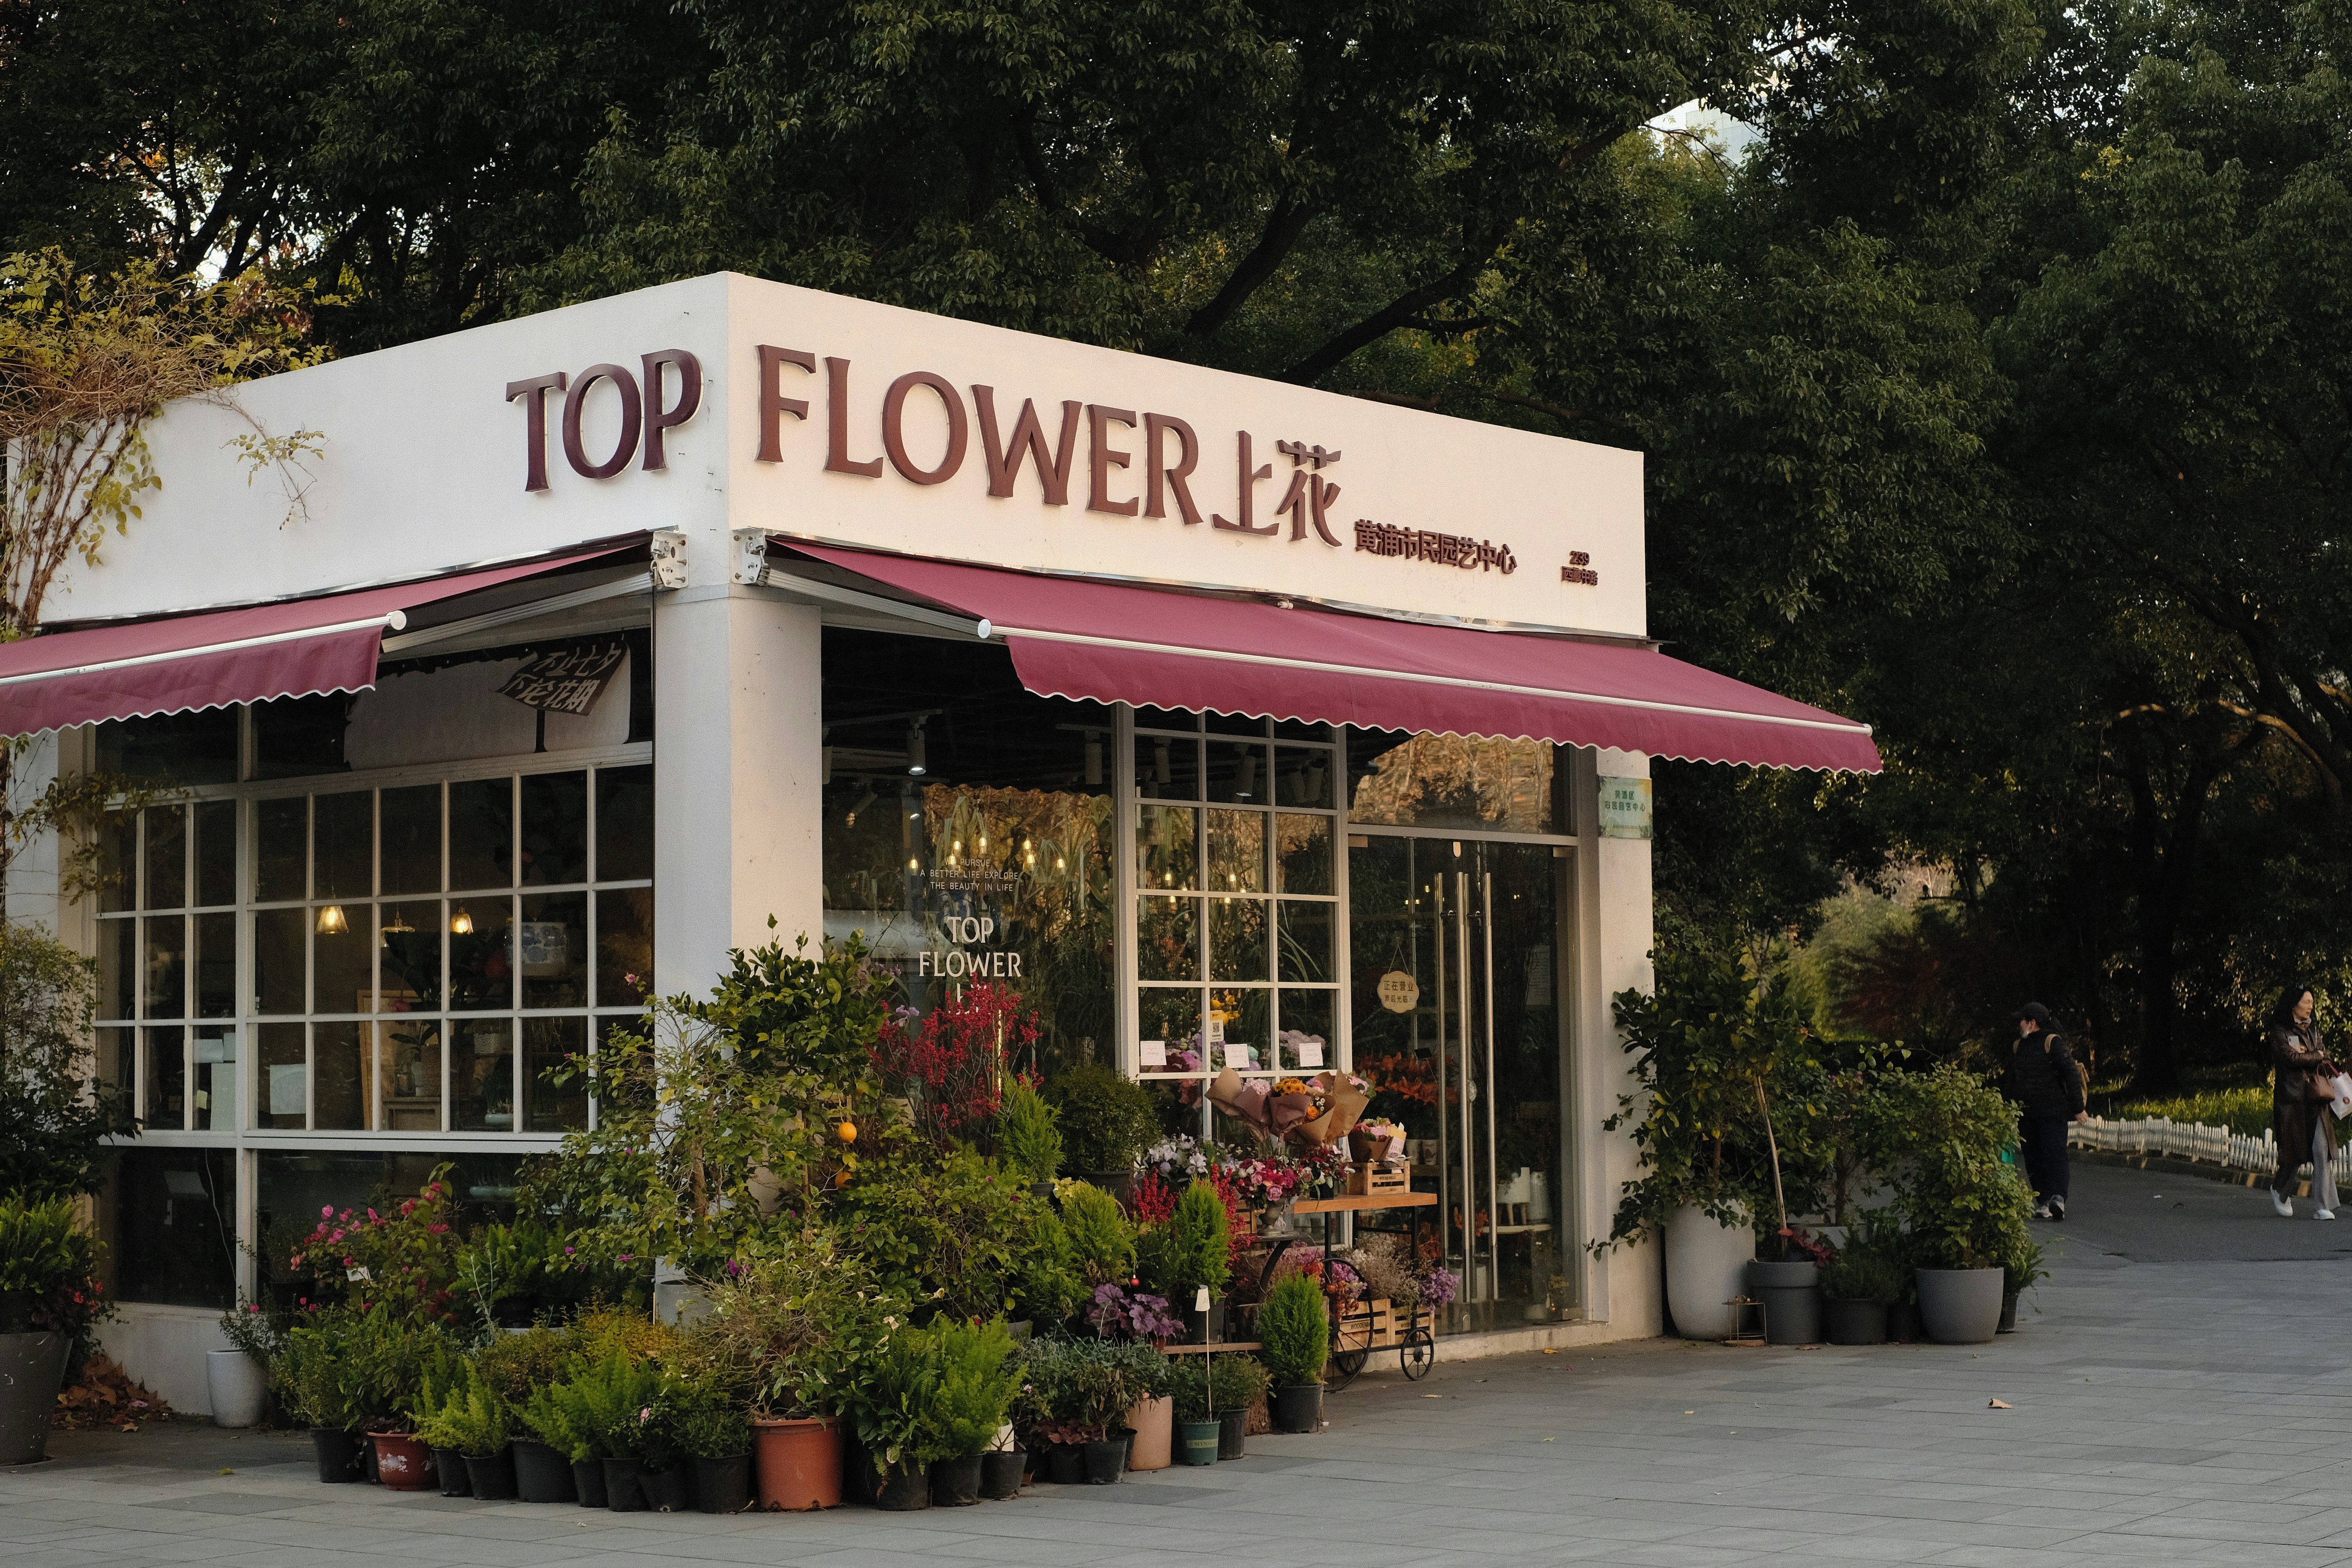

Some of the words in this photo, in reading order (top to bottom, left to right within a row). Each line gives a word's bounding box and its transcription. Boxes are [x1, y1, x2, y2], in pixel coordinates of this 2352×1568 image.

[506, 348, 704, 493] TOP
[755, 344, 1204, 525] FLOWER
[1210, 430, 1343, 547] 上花
[1354, 519, 1517, 574] 黄浦市民园艺中心
[1570, 550, 1590, 566] 239
[1561, 566, 1598, 586] 西藏中路
[960, 858, 990, 867] PURSUE
[930, 869, 959, 878] BETTER
[985, 871, 1018, 880] EXPLORE
[950, 882, 980, 891] BEAUTY
[947, 916, 994, 943] TOP
[919, 951, 1022, 977] FLOWER
[1383, 981, 1414, 991] 正在营业
[1350, 1321, 1370, 1330] WOODENB
